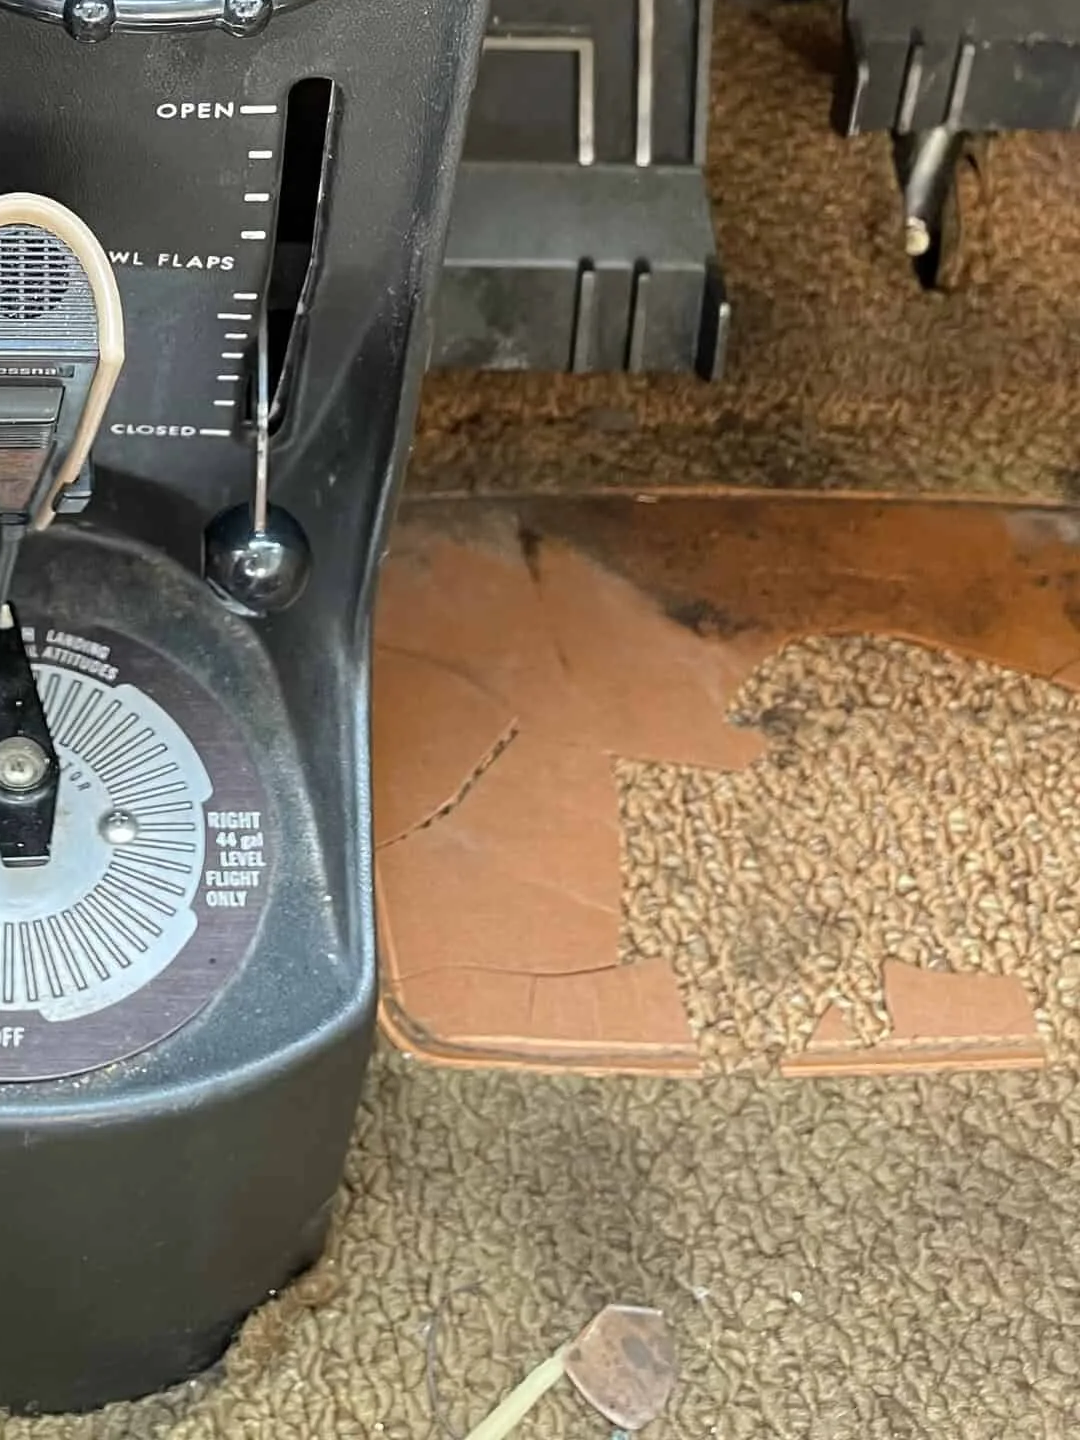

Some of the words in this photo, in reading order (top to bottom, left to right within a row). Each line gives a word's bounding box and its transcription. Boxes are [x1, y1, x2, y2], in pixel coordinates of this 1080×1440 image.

[156, 101, 235, 118] OPEN
[158, 253, 235, 270] FLAPS
[110, 423, 196, 437] CLOSED
[46, 628, 111, 660] LANDING
[41, 646, 120, 681] ATTITUDES
[207, 811, 261, 830] RIGHT
[220, 850, 267, 867] LEVEL
[205, 869, 260, 888] FLIGHT
[206, 889, 247, 907] ONLY
